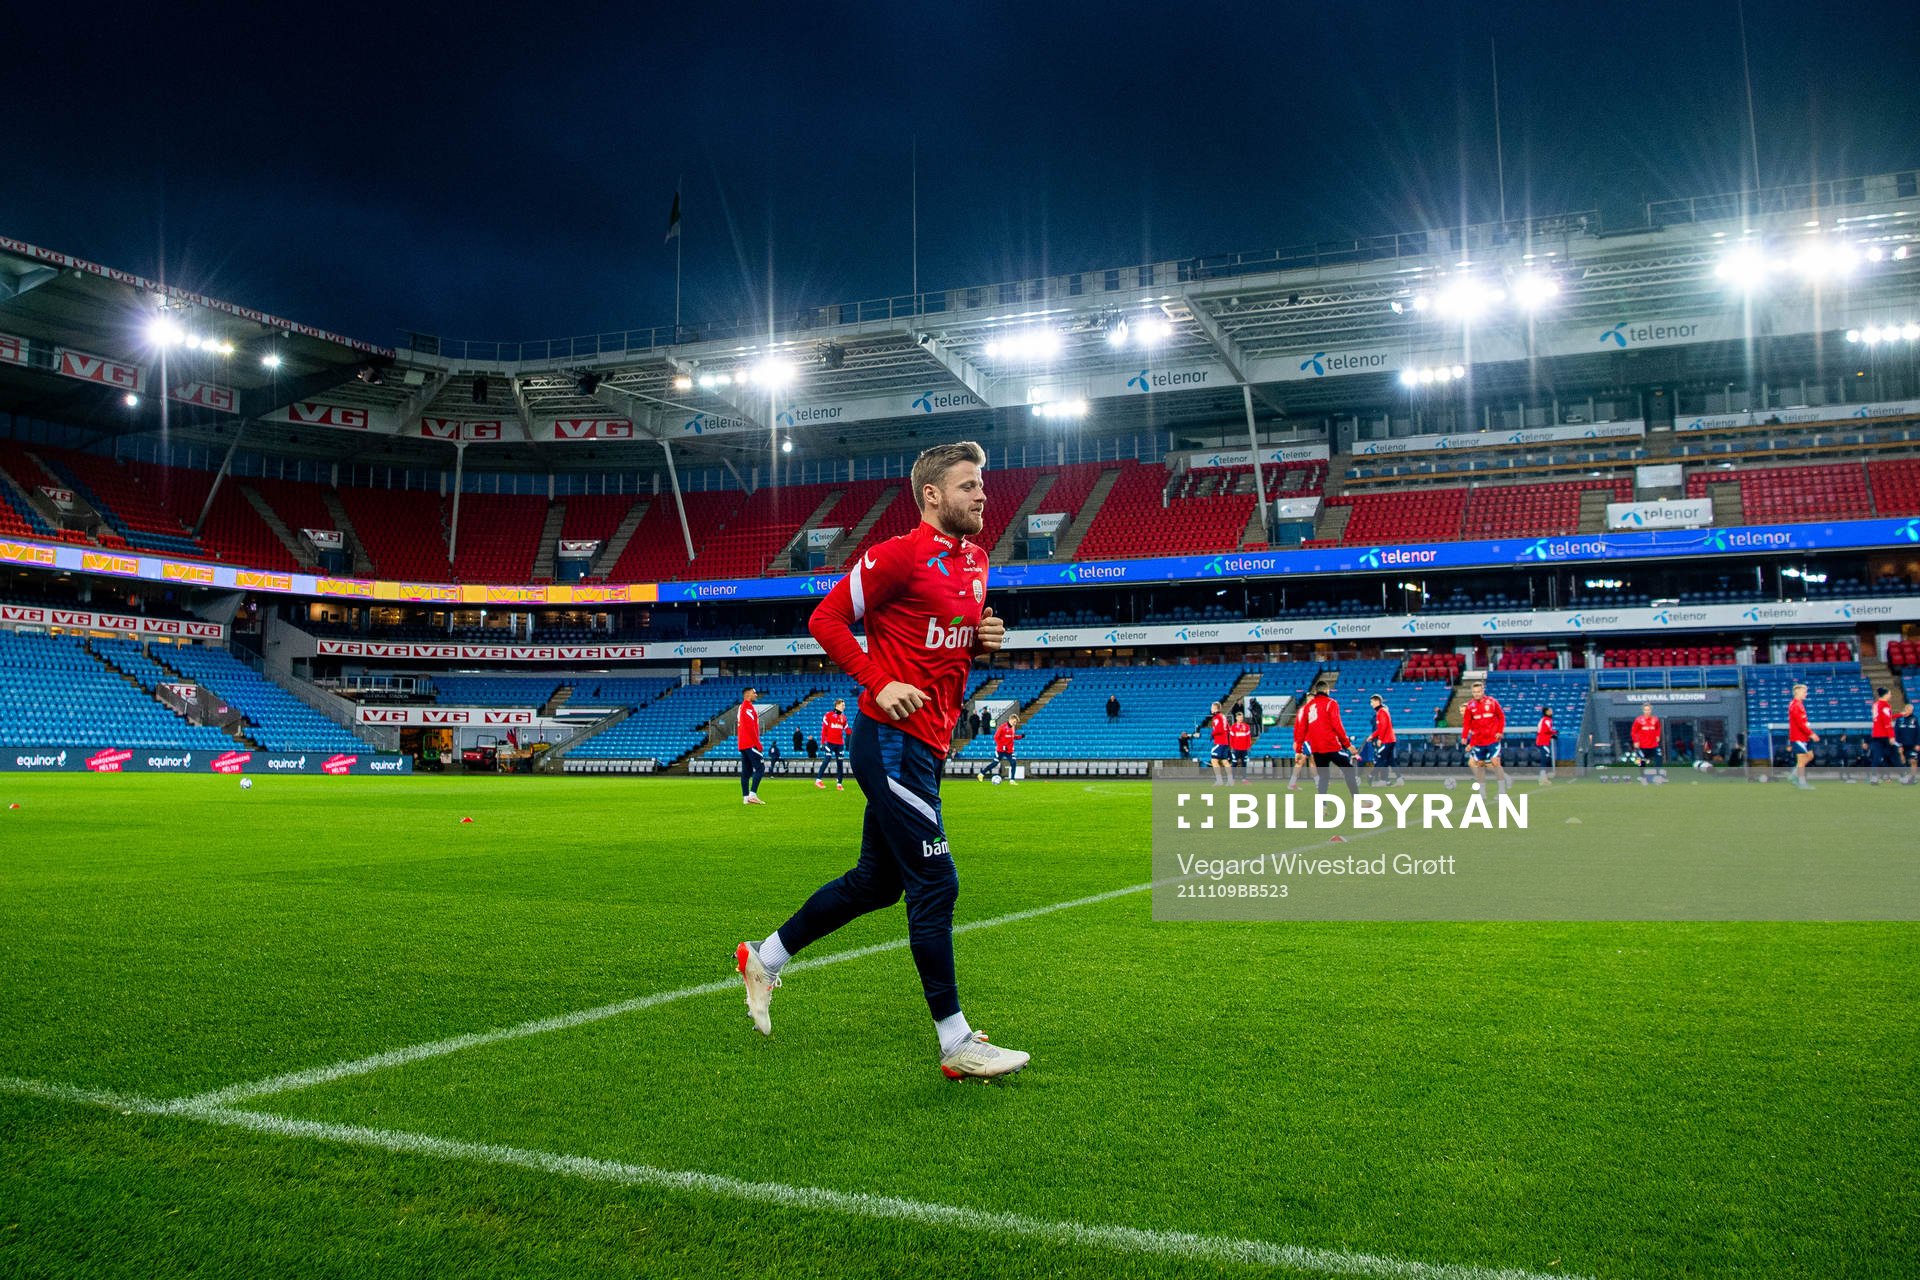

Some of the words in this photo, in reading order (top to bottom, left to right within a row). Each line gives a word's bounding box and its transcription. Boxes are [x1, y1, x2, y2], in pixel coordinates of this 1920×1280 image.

[1630, 323, 1698, 341] telenor
[1327, 352, 1388, 370] telenor
[64, 352, 135, 387] VG
[1152, 371, 1208, 386] telenor
[298, 404, 366, 428] VG
[425, 418, 497, 439] VG
[557, 420, 631, 438] VG
[796, 406, 842, 421] telenor
[1376, 443, 1406, 452] telenor
[1448, 439, 1480, 447] telenor
[1522, 432, 1554, 442] telenor
[1219, 456, 1247, 464] telenor
[1282, 451, 1312, 459] telenor
[1644, 507, 1699, 521] telenor
[699, 584, 737, 596] telenor
[1079, 564, 1126, 579] telenor
[1225, 556, 1276, 572] telenor
[1381, 549, 1437, 564] telenor
[1549, 540, 1607, 556] telenor
[1729, 531, 1791, 547] telenor
[0, 543, 55, 565] VG
[83, 553, 138, 575] VG
[163, 563, 213, 582] VG
[237, 573, 291, 590] VG
[317, 579, 373, 596] VG
[402, 585, 458, 601] VG
[488, 587, 545, 601] VG
[574, 587, 627, 601] VG
[4, 607, 43, 621] VG
[54, 612, 91, 625] VG
[101, 616, 136, 629] VG
[146, 620, 179, 633] VG
[188, 624, 220, 636] VG
[1049, 634, 1077, 642] telenor
[1117, 631, 1147, 640] telenor
[1188, 629, 1219, 638] telenor
[1261, 627, 1293, 635] telenor
[1338, 624, 1370, 633] telenor
[1416, 621, 1450, 630] telenor
[1497, 618, 1532, 627] telenor
[1582, 615, 1618, 625] telenor
[1669, 611, 1706, 622] telenor
[1759, 608, 1797, 619] telenor
[1852, 604, 1892, 616] telenor
[925, 616, 978, 649] bam
[322, 642, 361, 654] VG
[368, 645, 409, 656] VG
[416, 646, 457, 657] VG
[465, 648, 506, 658] VG
[513, 648, 553, 658] VG
[560, 648, 599, 658] VG
[606, 648, 642, 657] VG
[683, 645, 707, 654] telenor
[739, 644, 764, 652] telenor
[365, 710, 407, 721] VG
[425, 711, 468, 722] VG
[487, 712, 530, 723] VG
[17, 755, 56, 768] equinor
[148, 755, 183, 768] equinor
[268, 758, 298, 770] equinor
[370, 760, 397, 771] equinor
